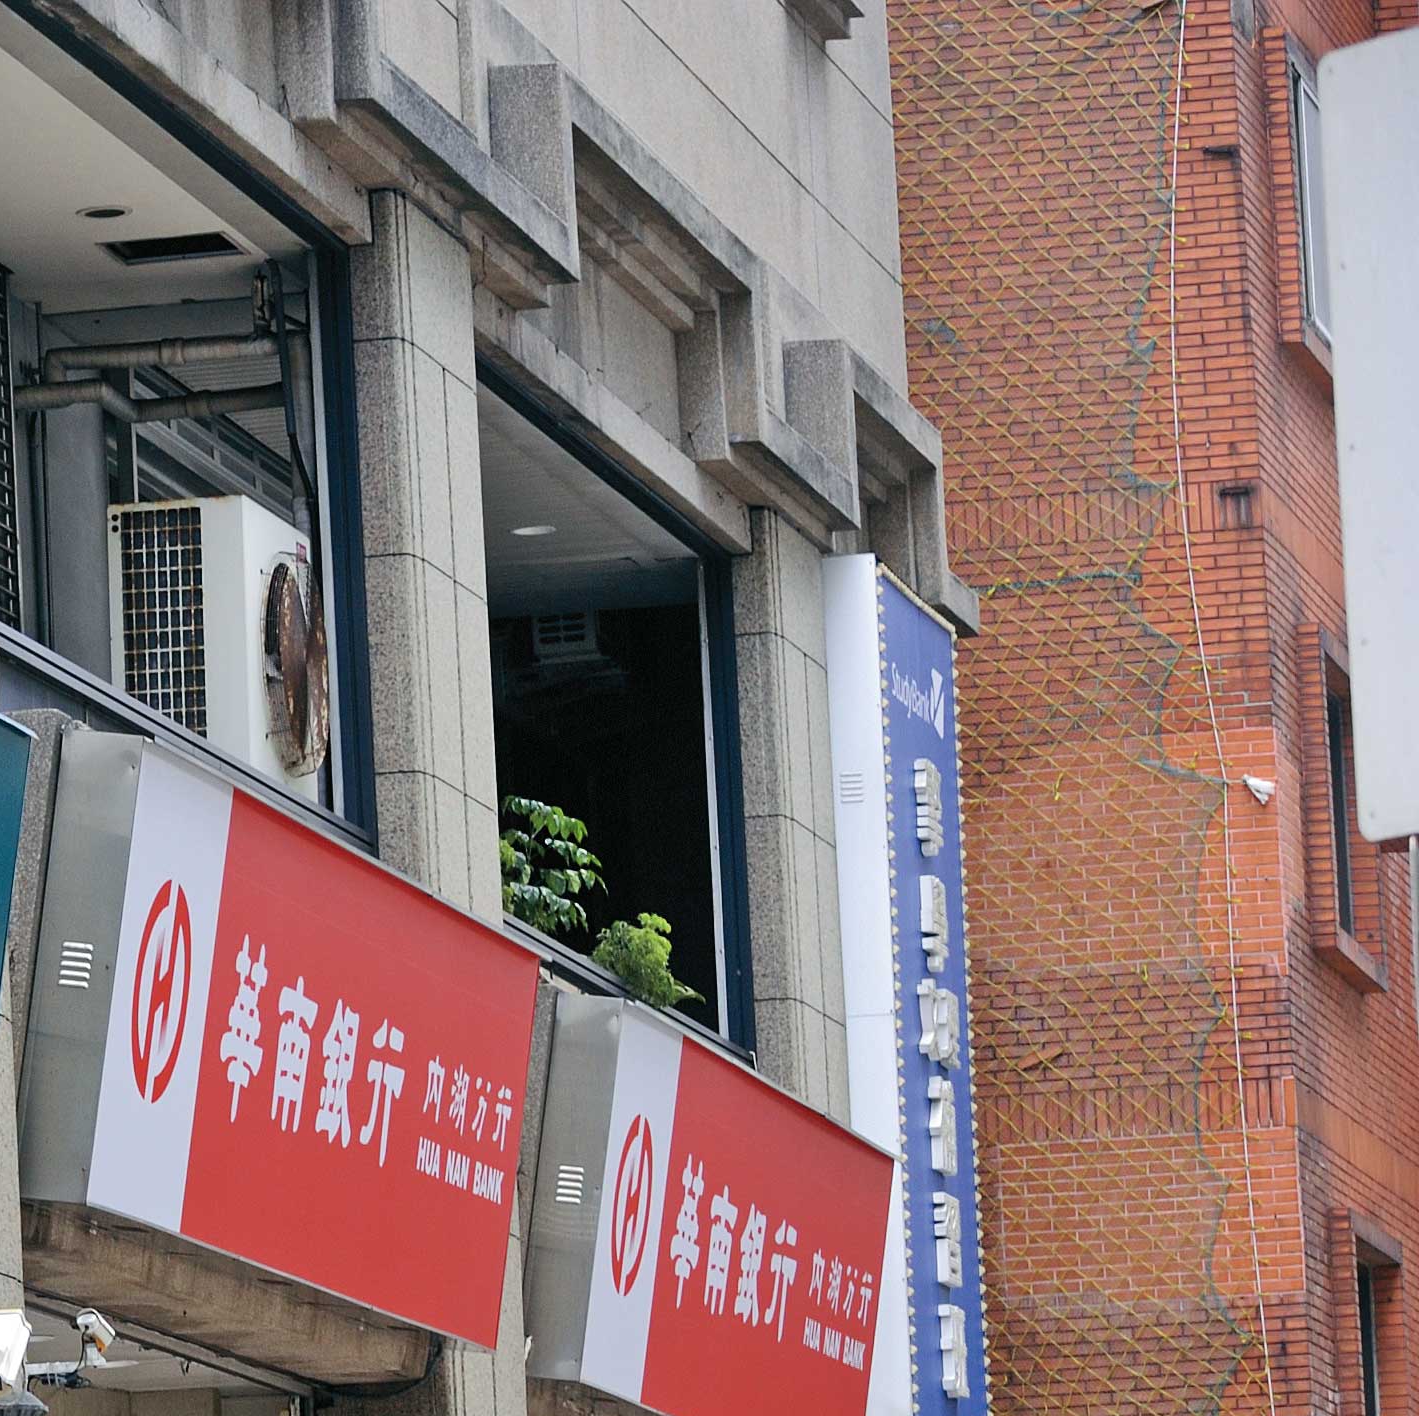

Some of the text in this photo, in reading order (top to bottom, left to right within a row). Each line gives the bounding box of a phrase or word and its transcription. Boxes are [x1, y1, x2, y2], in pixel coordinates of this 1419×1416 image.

[891, 661, 932, 725] StudyBank
[219, 933, 406, 1168] 華南銀行
[424, 1054, 513, 1153] 內湖分行
[415, 1135, 504, 1207] HUA NAN BANK
[669, 1153, 799, 1344] 華南銀行
[808, 1247, 874, 1327] 內湖分行
[802, 1316, 866, 1373] HUA NAN BANK
